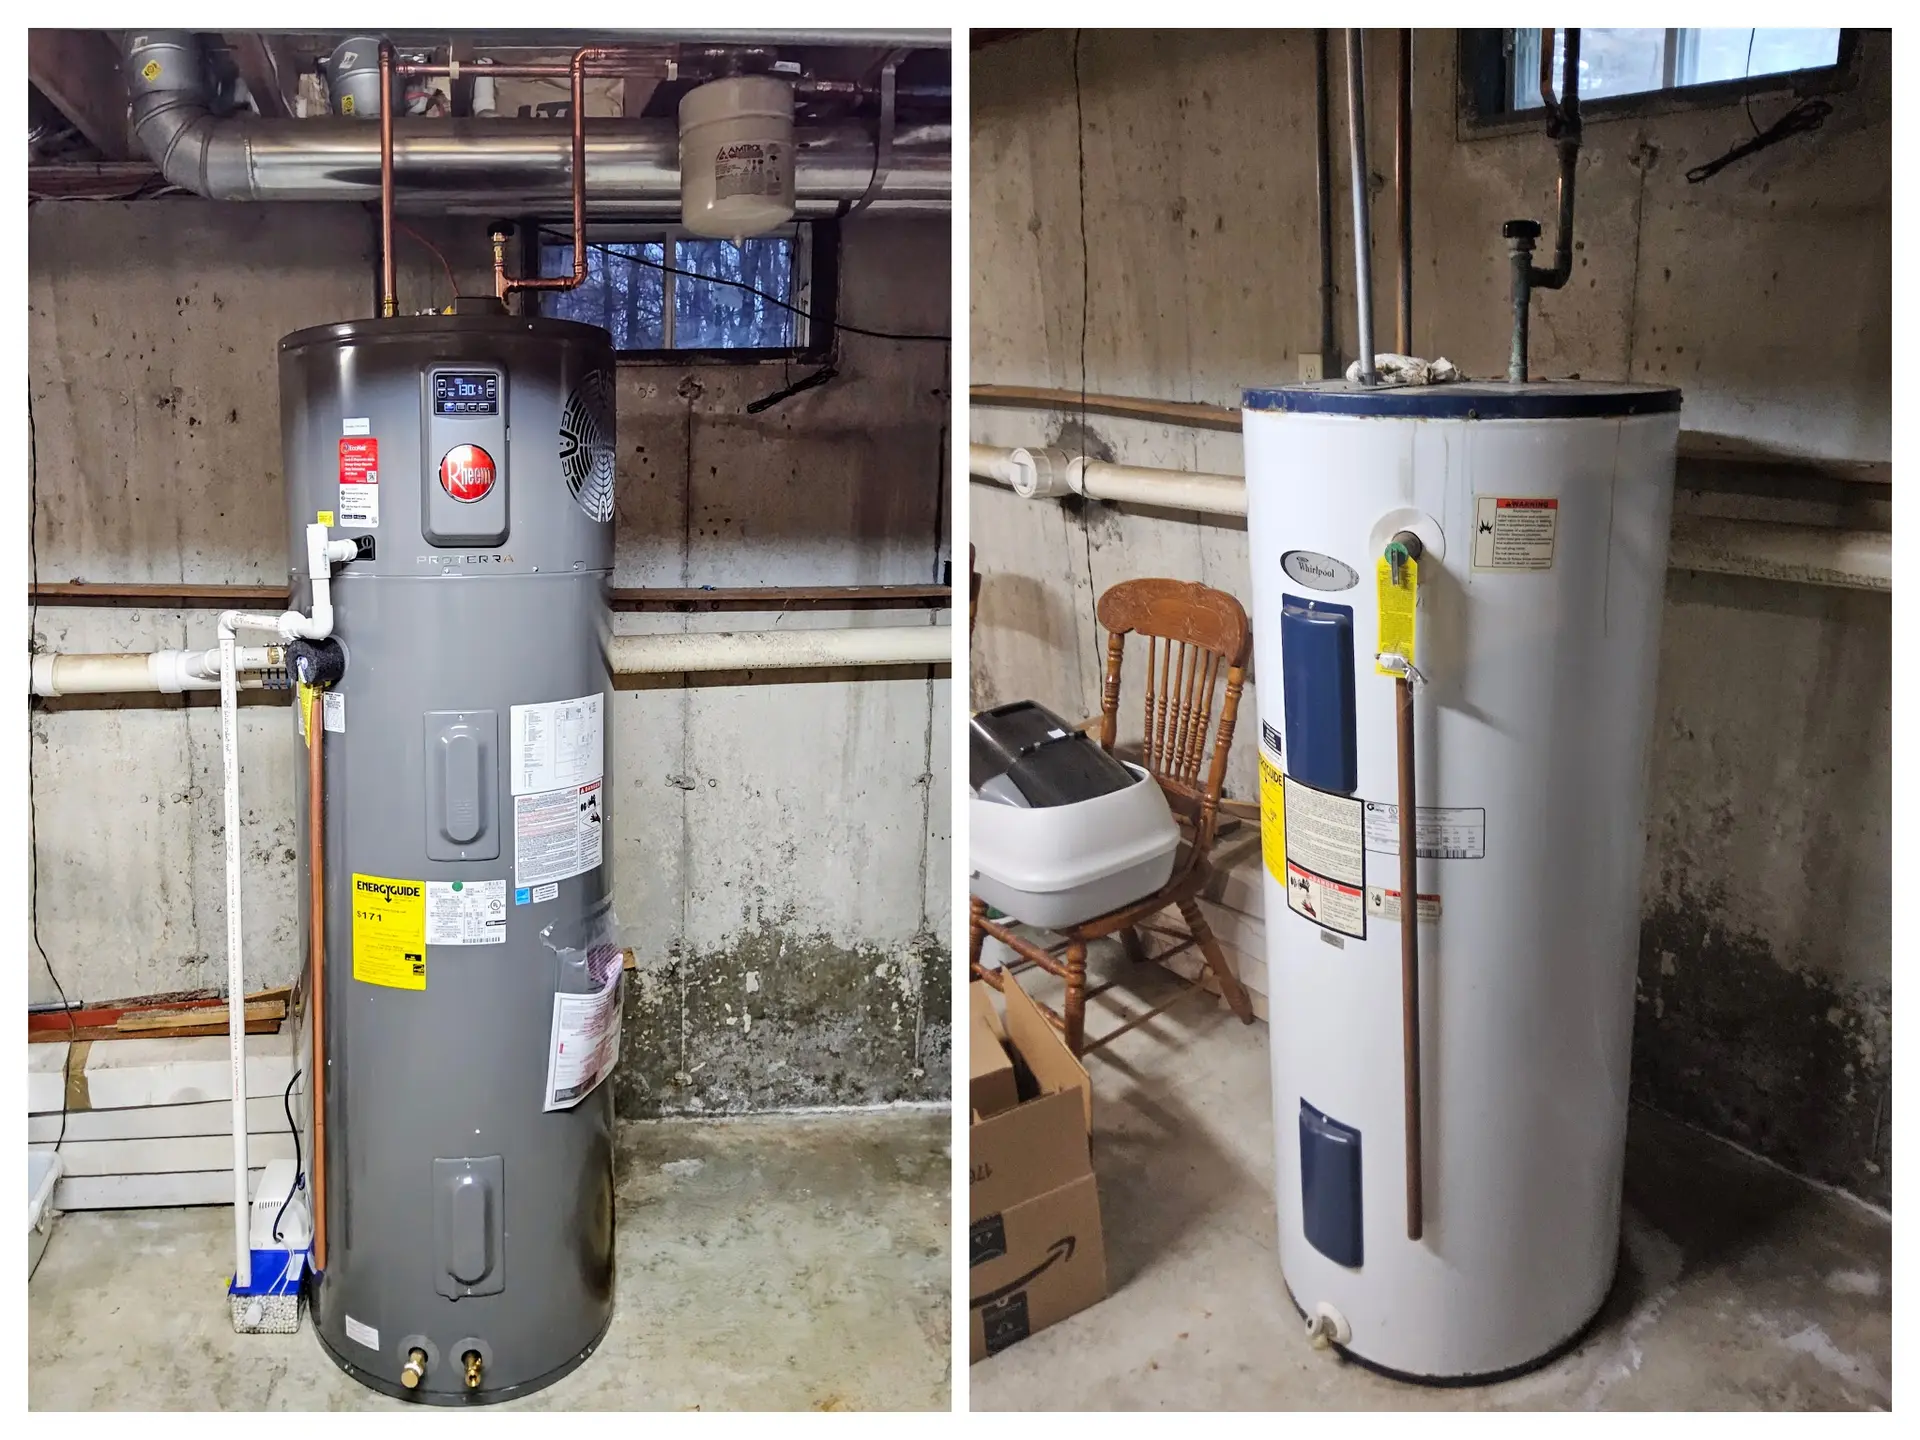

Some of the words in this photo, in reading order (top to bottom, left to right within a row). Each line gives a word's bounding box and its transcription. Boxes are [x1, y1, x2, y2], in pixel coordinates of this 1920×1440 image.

[448, 460, 491, 492] Rheem
[1512, 501, 1549, 509] WARNING
[416, 554, 514, 565] PROTERRA
[1298, 561, 1335, 578] Whirlpool
[357, 880, 420, 898] ENERGYGUIDE
[1312, 876, 1339, 890] DANGER
[357, 911, 383, 922] $171
